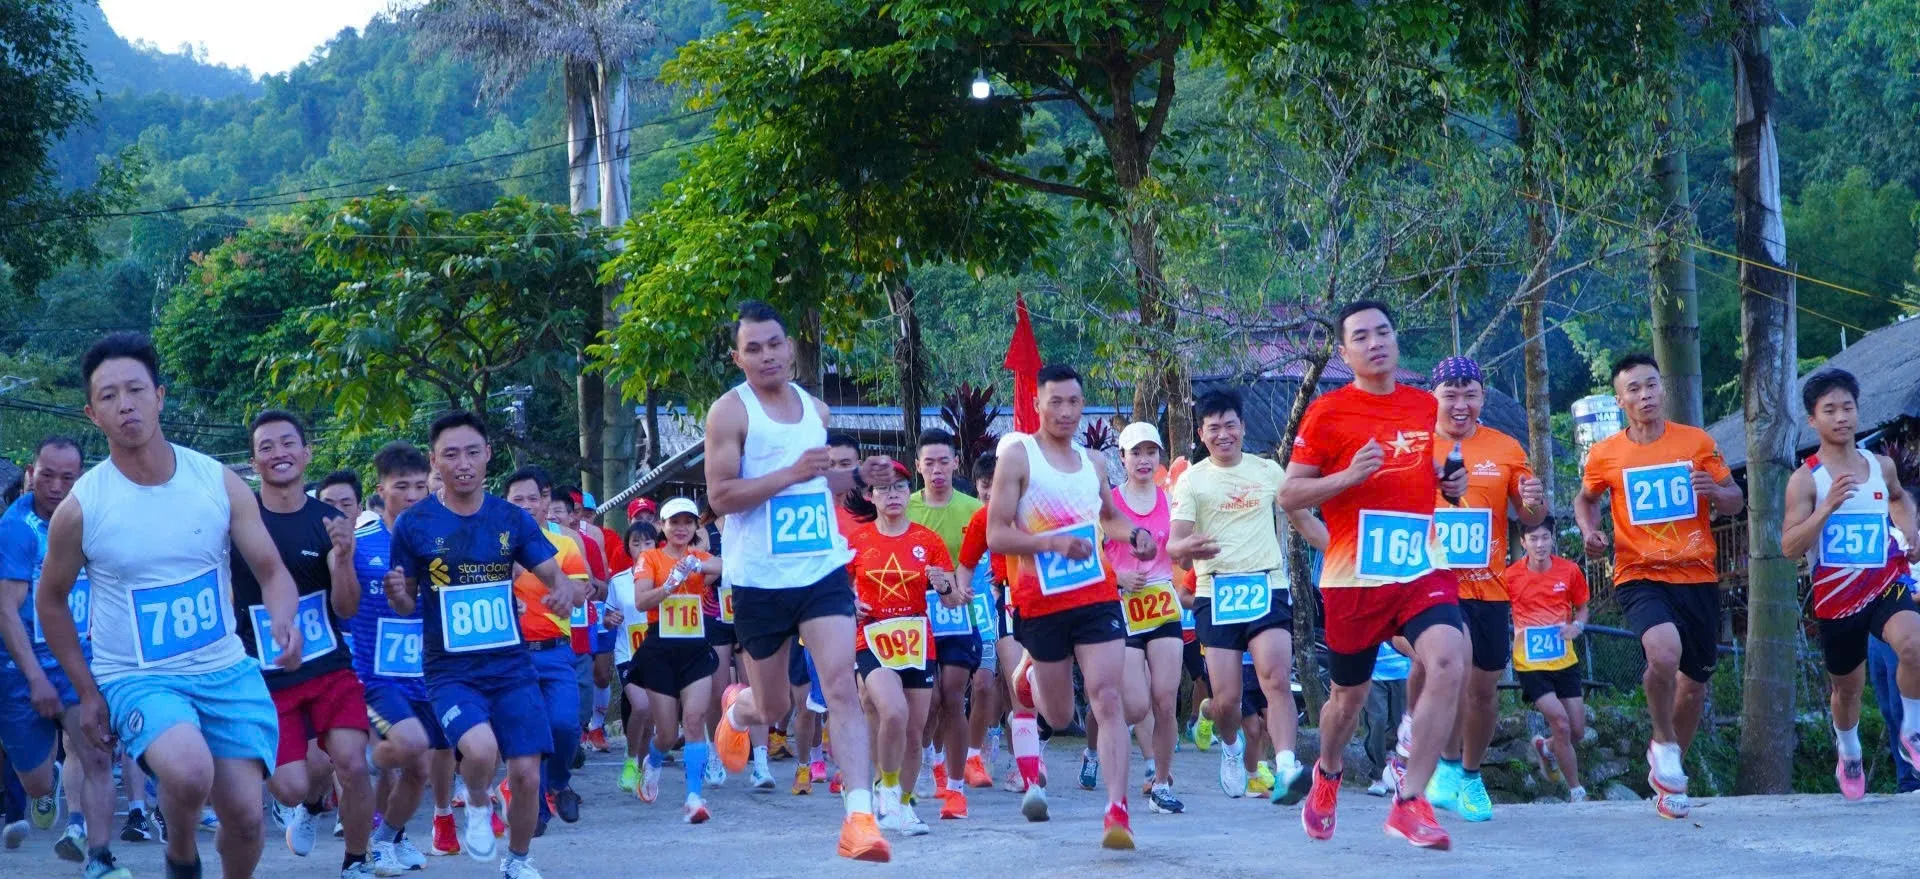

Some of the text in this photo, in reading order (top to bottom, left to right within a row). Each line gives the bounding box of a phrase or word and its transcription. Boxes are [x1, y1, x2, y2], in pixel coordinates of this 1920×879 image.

[1220, 500, 1260, 511] FINISHER
[1634, 476, 1689, 510] 216
[776, 504, 827, 542] 226
[1435, 521, 1485, 554] 208
[1369, 528, 1424, 567] 169
[1827, 524, 1880, 554] 257
[1128, 591, 1175, 622] 022
[1218, 584, 1266, 612] 222
[141, 587, 218, 646] 789
[452, 597, 509, 635] 800
[665, 605, 699, 627] 116
[875, 629, 920, 660] 092
[1532, 634, 1562, 654] 241
